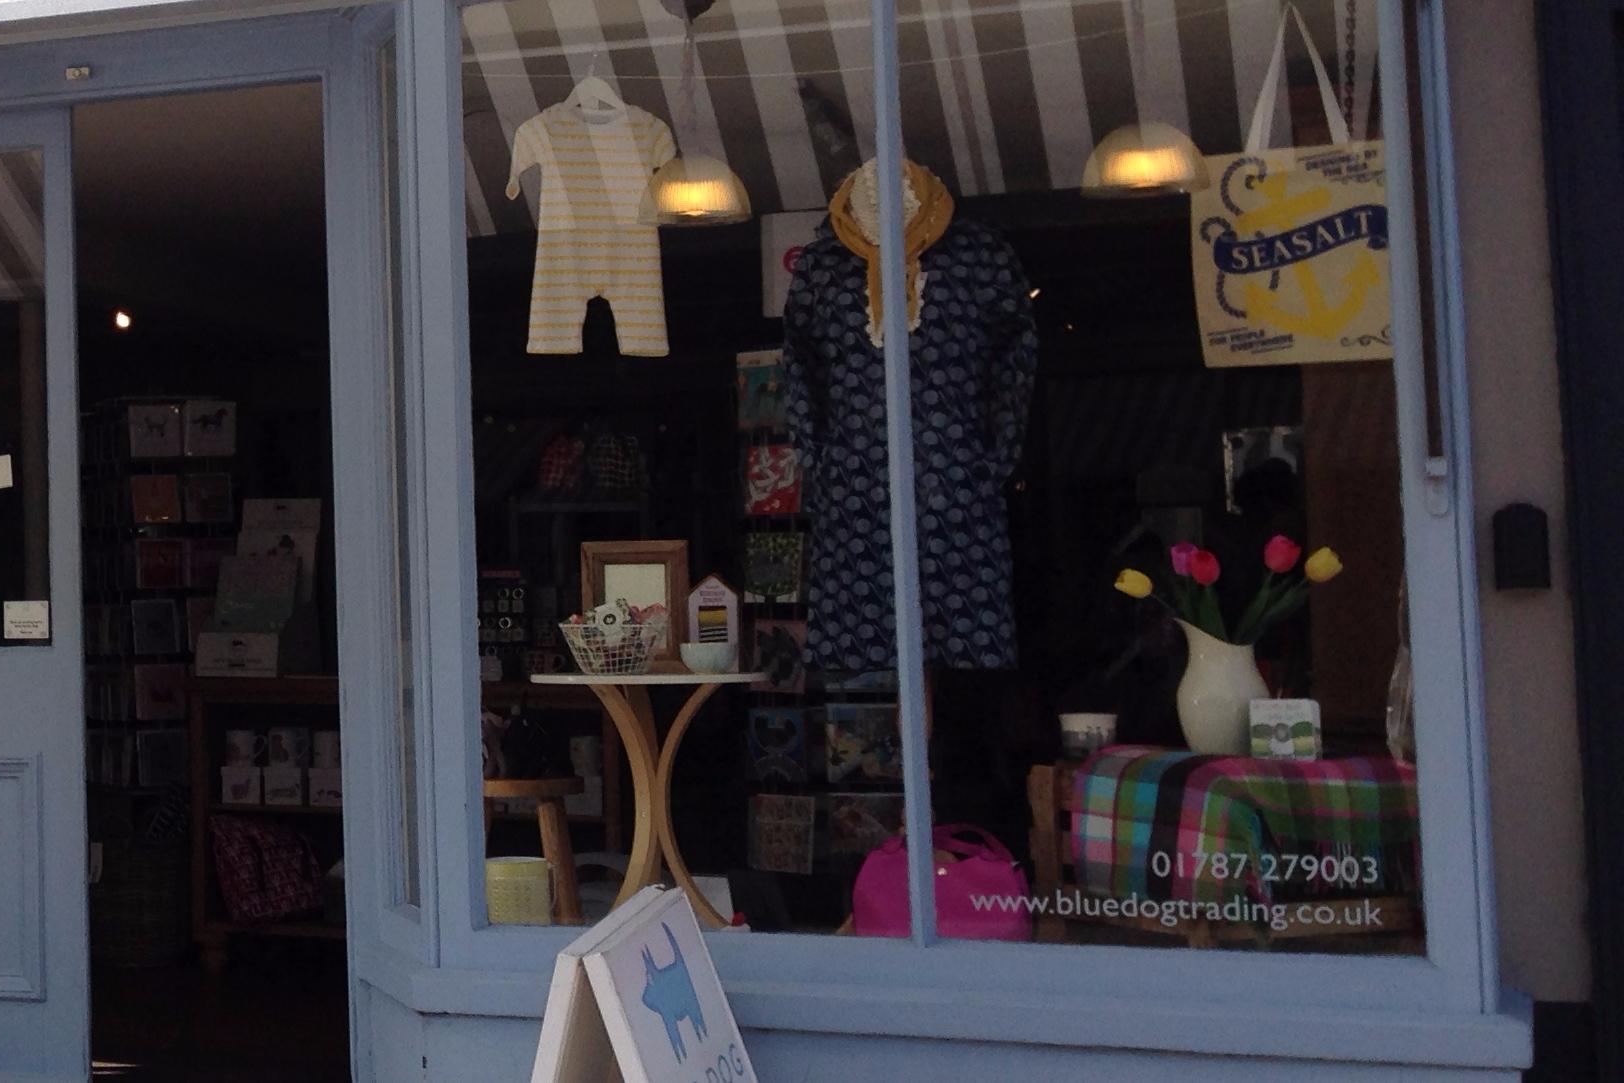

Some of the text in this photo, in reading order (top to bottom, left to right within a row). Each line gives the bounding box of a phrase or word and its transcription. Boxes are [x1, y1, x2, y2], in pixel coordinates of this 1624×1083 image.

[1230, 210, 1374, 270] SEASALT
[1152, 850, 1379, 884] 01787 279003
[970, 889, 1383, 930] www.bluedogtrading.co.uk
